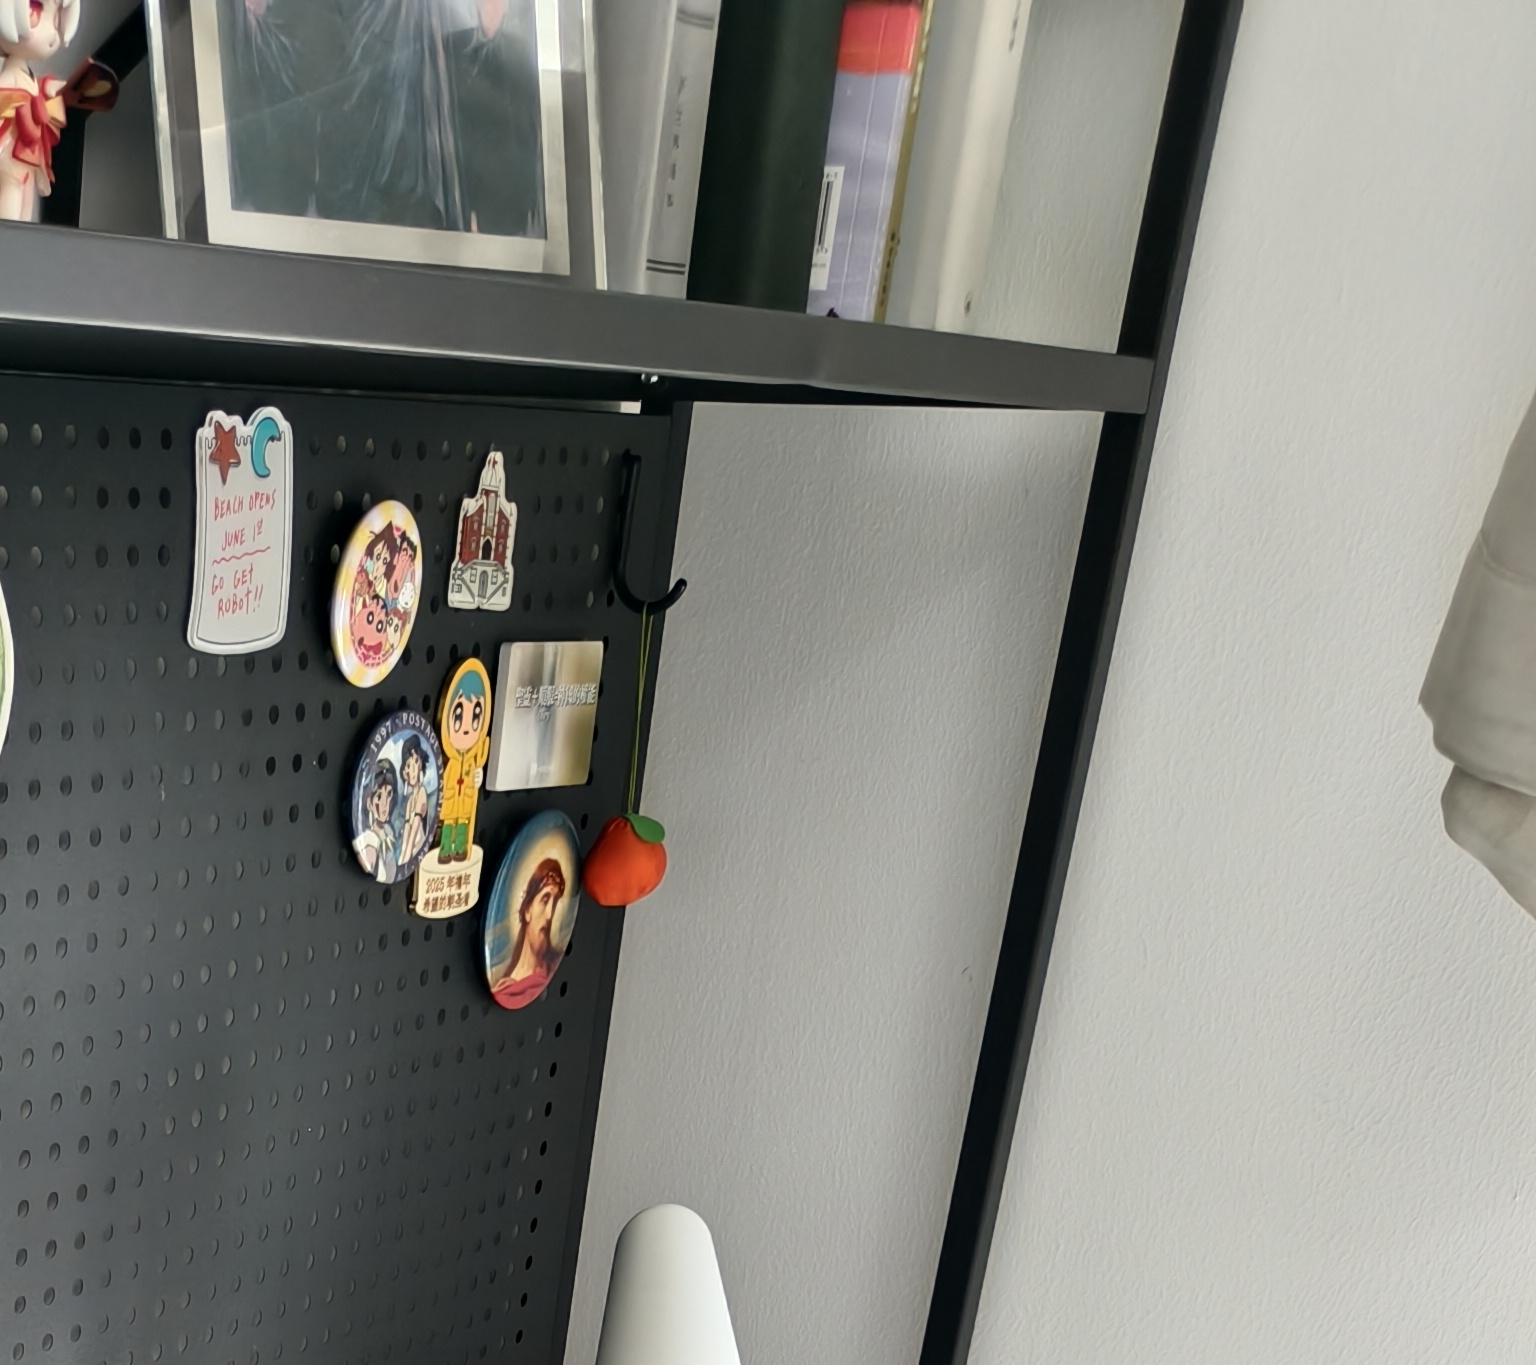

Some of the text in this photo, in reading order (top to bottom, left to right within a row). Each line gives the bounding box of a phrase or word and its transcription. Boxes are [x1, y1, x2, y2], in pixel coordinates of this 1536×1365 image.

[214, 489, 276, 522] BEACH OPENS
[222, 526, 246, 551] JUNE
[211, 563, 254, 595] GO GET
[217, 584, 264, 620] ROBOT!!
[371, 712, 440, 753] 1997 POSTAGE
